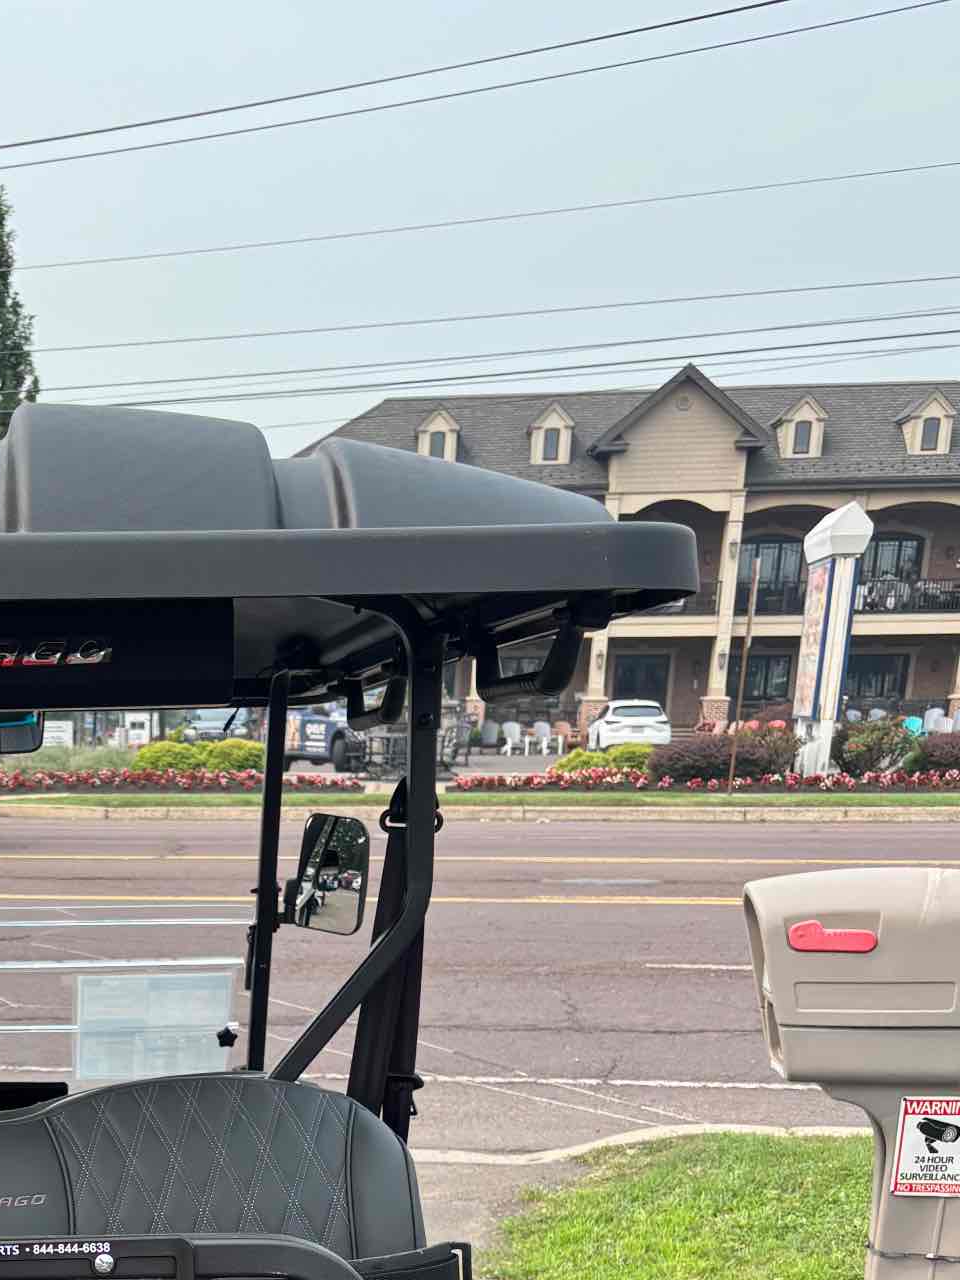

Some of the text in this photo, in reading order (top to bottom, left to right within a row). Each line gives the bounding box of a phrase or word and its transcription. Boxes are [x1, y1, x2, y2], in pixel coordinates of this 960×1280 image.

[914, 1156, 954, 1164] 24 HOUR
[920, 1164, 948, 1172] VIDEO
[896, 1183, 960, 1193] NO TRESPASSIN
[33, 1242, 111, 1255] 844-844-6638
